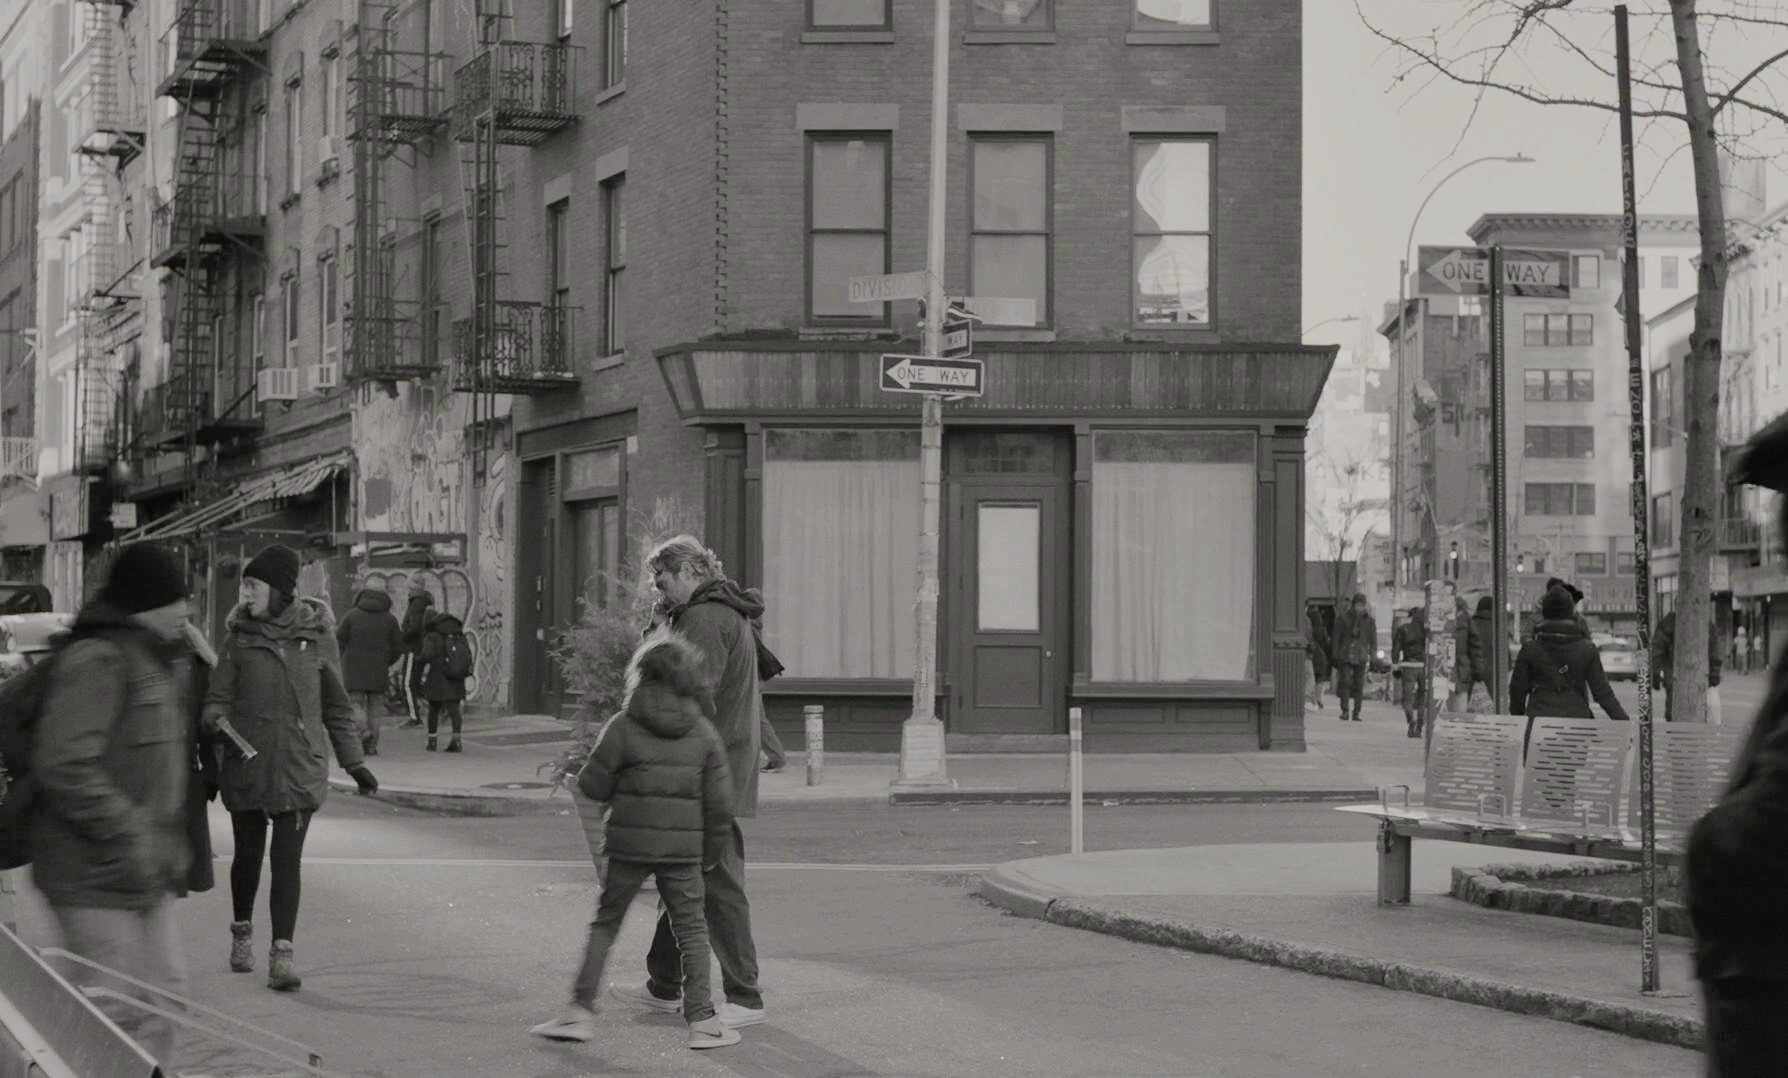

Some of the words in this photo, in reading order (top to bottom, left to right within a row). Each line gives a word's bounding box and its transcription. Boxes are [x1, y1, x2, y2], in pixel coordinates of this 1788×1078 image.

[1443, 262, 1484, 280] ONE
[1506, 263, 1549, 283] WAY
[897, 366, 925, 381] ONE
[939, 369, 969, 384] WAY
